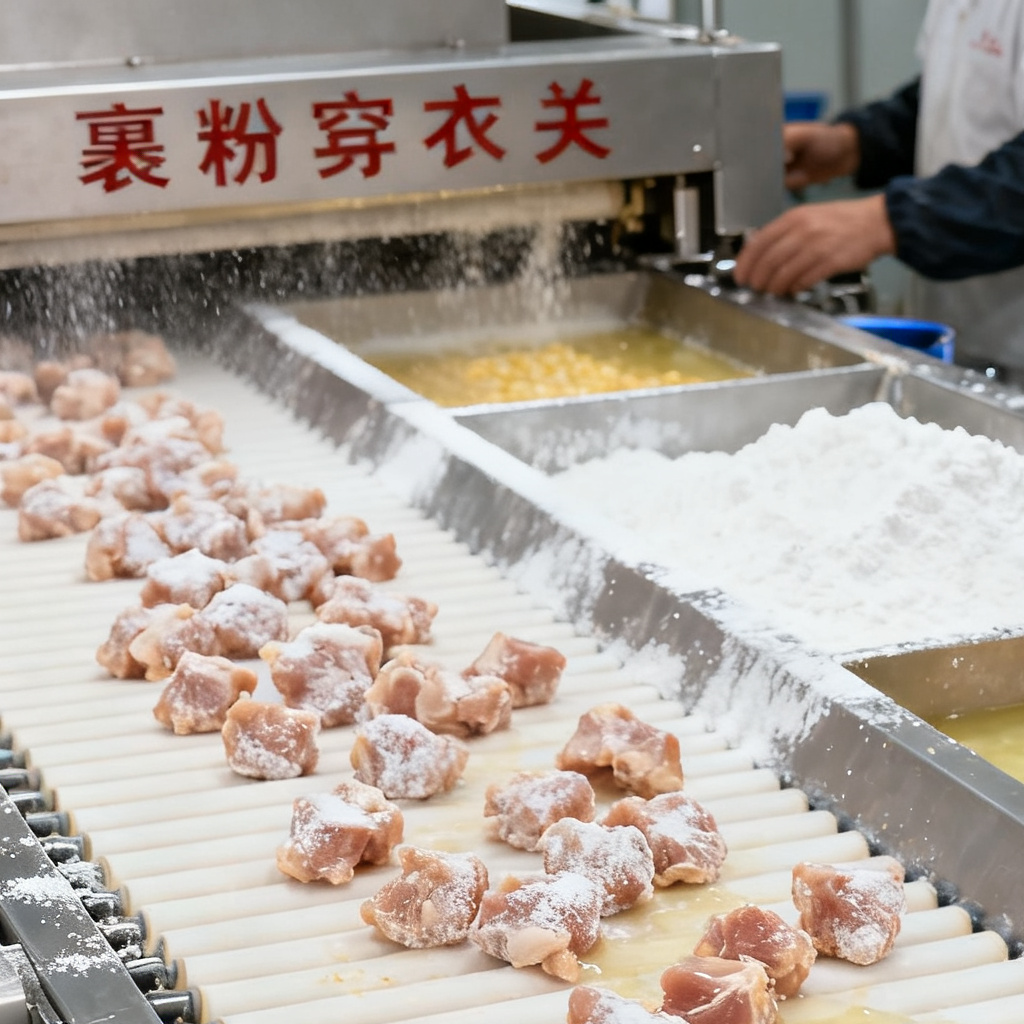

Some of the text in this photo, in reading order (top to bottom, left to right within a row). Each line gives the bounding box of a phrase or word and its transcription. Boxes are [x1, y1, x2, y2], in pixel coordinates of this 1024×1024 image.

[75, 78, 612, 193] 裹粉穿衣关
